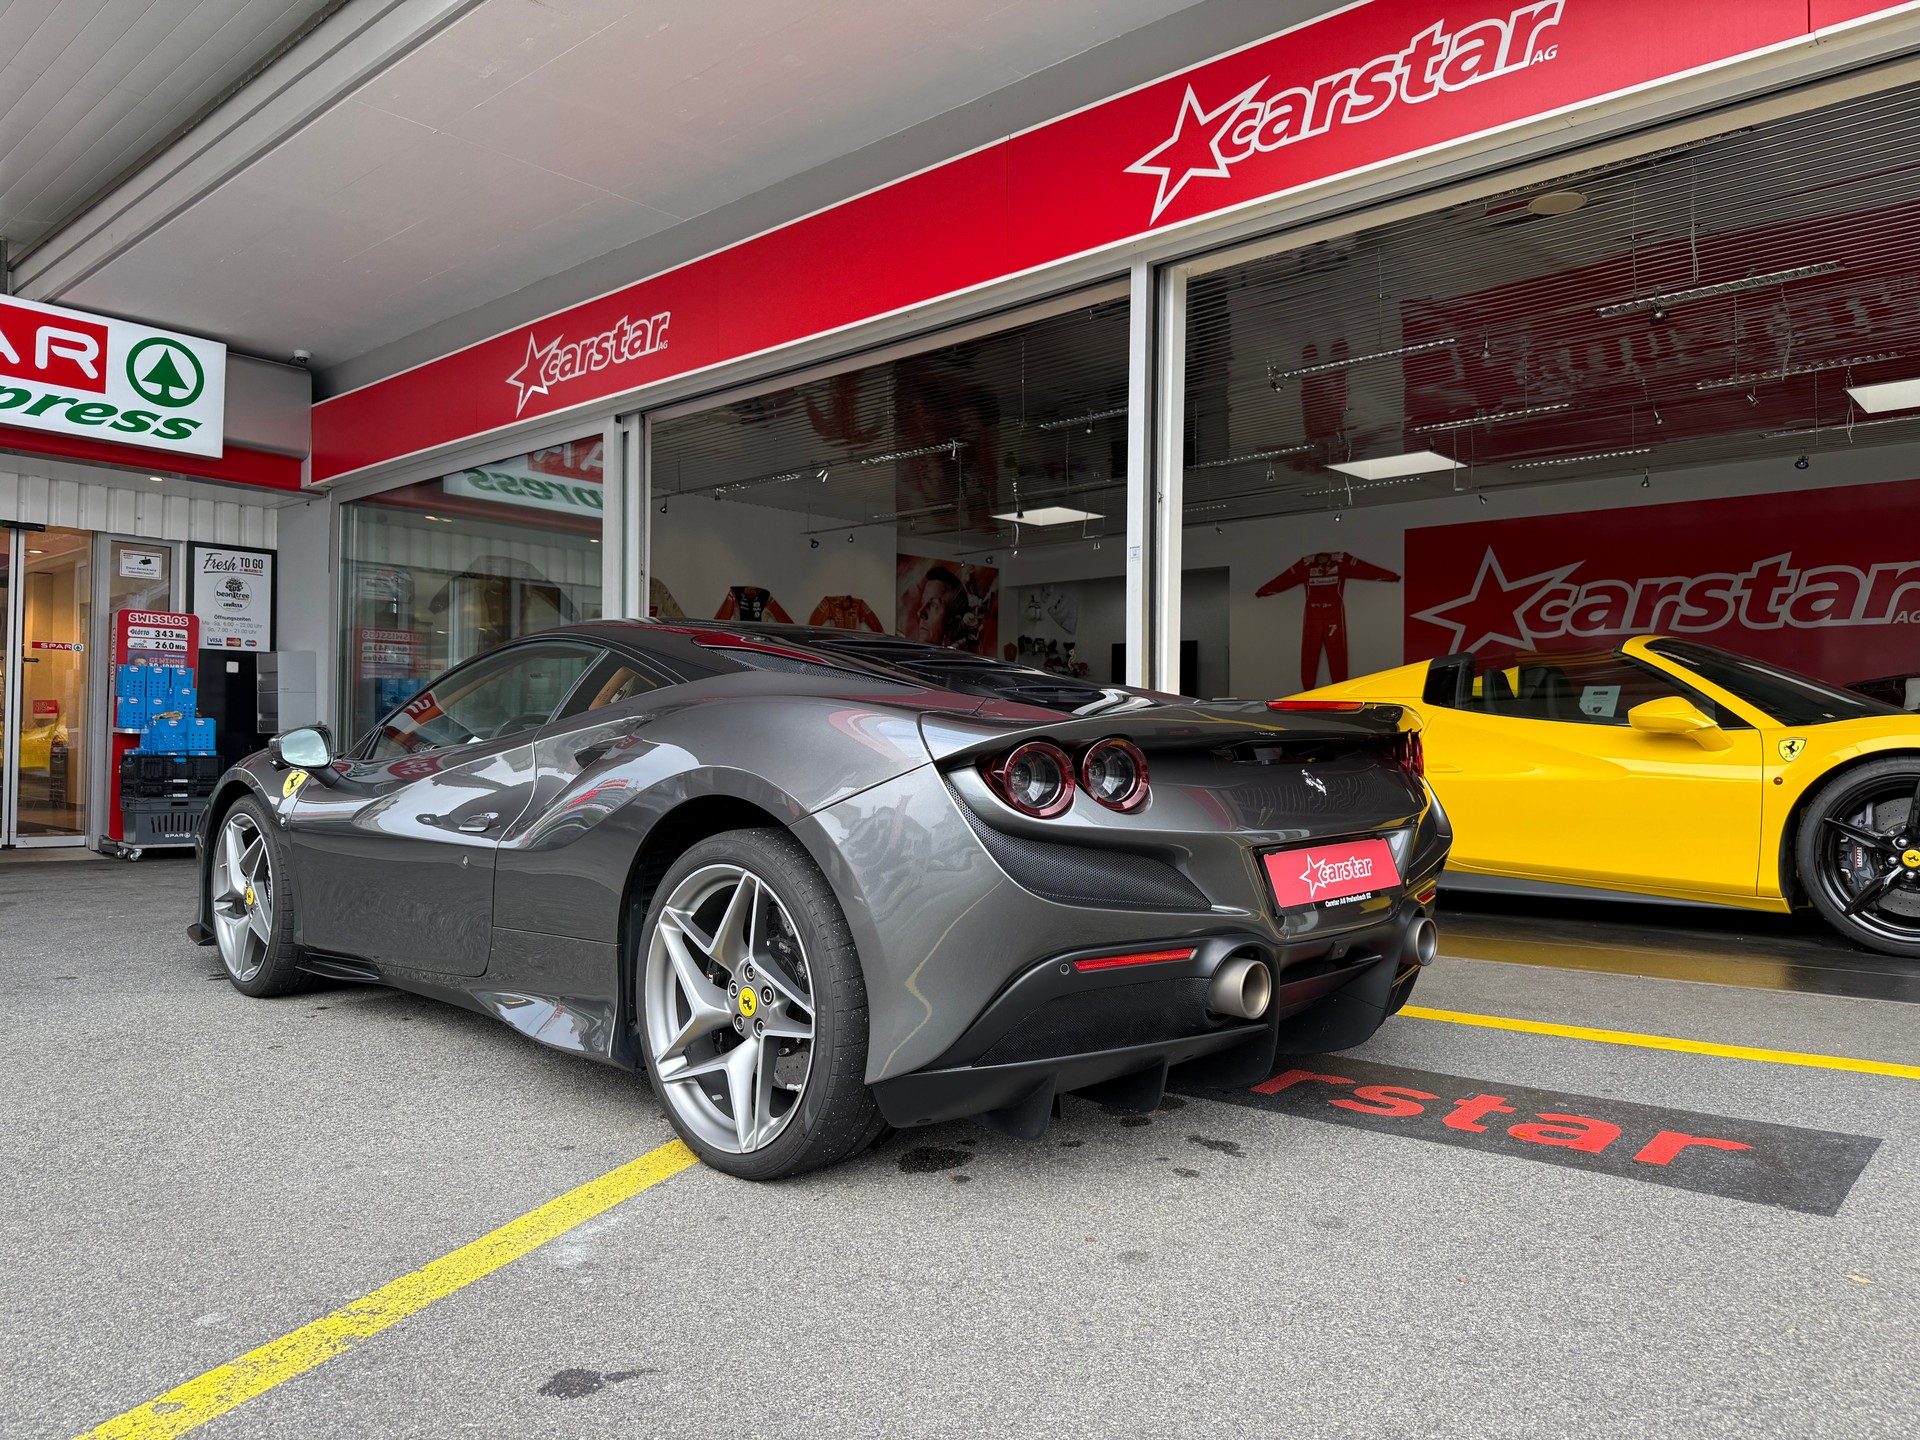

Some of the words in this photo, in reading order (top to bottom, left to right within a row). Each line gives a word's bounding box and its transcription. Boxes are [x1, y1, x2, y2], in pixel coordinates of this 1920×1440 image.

[1209, 0, 1565, 163] carstar
[1531, 45, 1558, 66] AG
[540, 311, 671, 386] carstar
[658, 340, 668, 350] AG
[203, 553, 238, 571] Fresh
[240, 557, 250, 568] TO
[252, 558, 263, 569] GO
[1512, 551, 1920, 639] carstar
[1893, 610, 1920, 624] AG
[129, 613, 189, 626] SWISSLOS
[1328, 624, 1337, 636] 7
[41, 642, 72, 650] SPAR
[1318, 856, 1372, 884] carstar
